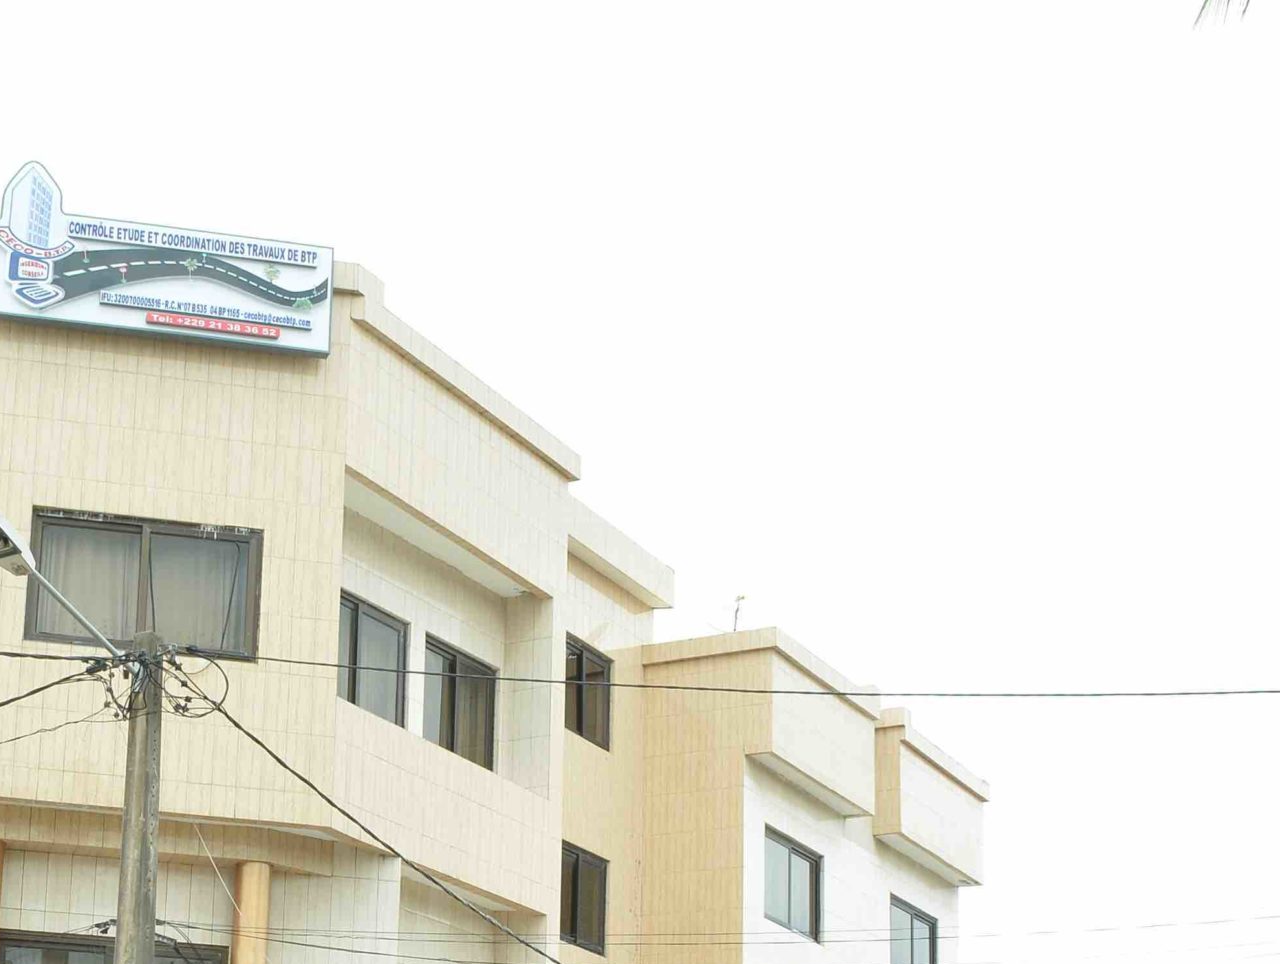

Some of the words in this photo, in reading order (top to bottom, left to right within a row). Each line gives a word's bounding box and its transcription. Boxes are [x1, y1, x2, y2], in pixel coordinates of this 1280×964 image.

[69, 221, 114, 239] CONTRÔLE
[117, 228, 146, 243] ETUDE
[148, 231, 160, 244] ET
[161, 232, 227, 253] COORDINATION
[229, 241, 245, 255] DES
[247, 243, 286, 260] TRAVAUX
[287, 248, 299, 262] DE
[301, 251, 318, 264] BTP
[177, 317, 205, 328] +229
[209, 321, 222, 330] 21
[227, 323, 240, 332] 38
[244, 325, 258, 335] 36
